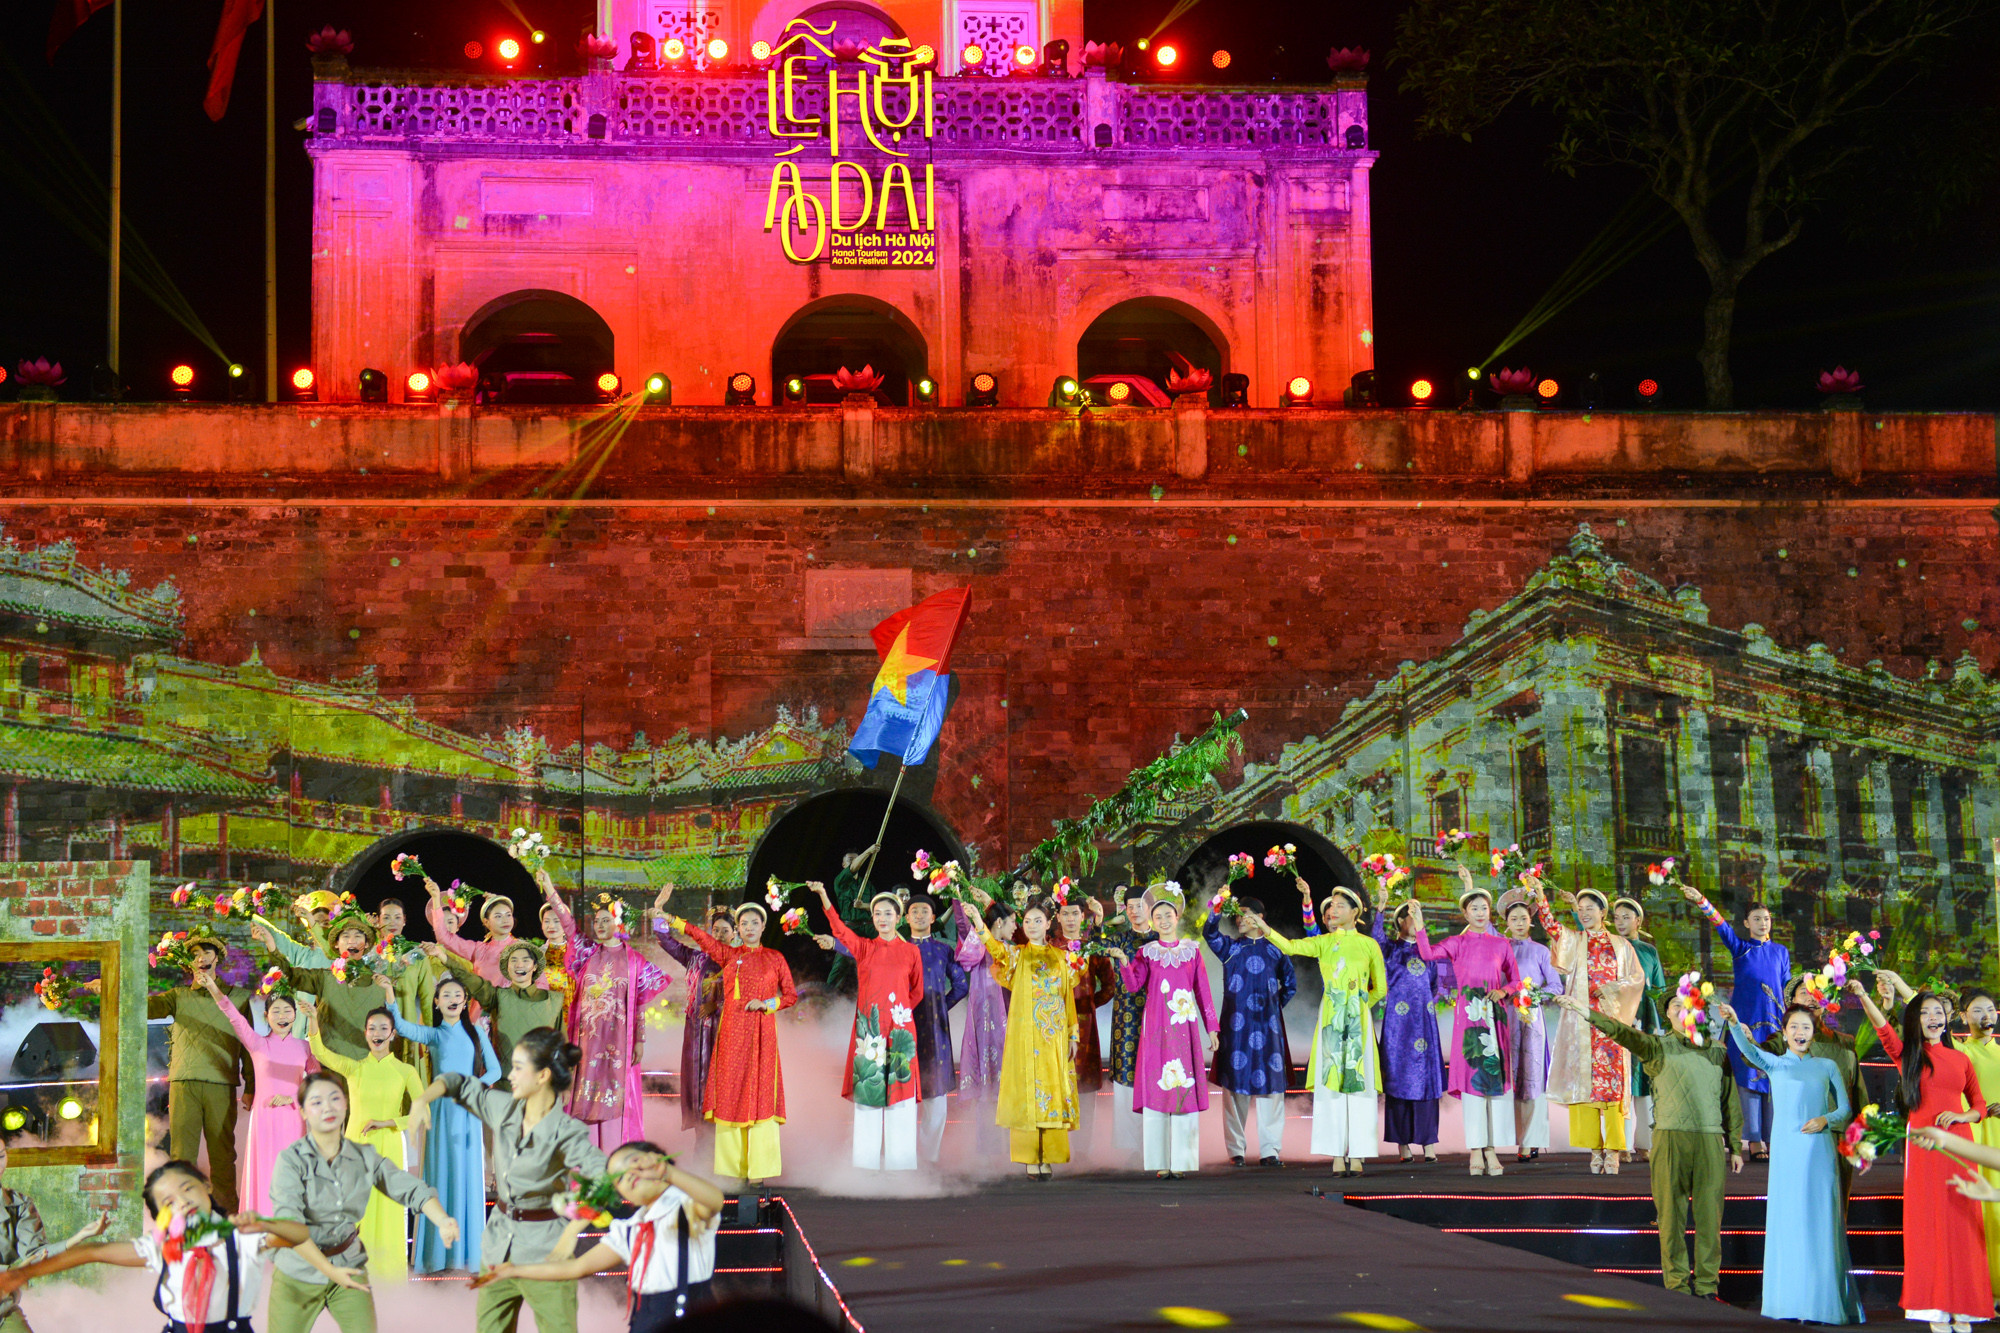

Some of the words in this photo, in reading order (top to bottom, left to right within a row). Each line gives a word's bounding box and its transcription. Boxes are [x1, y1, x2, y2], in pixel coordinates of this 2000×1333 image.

[768, 18, 836, 137] LỄ
[764, 143, 826, 262] ÁO
[831, 234, 852, 247] Du
[855, 233, 882, 250] lịch
[885, 233, 906, 247] Hà
[909, 233, 935, 250] Nội
[831, 249, 855, 257] Hanoi
[857, 249, 888, 257] Tourism
[831, 257, 843, 265] Ao
[844, 257, 857, 265] Dai
[858, 257, 888, 265] Festival
[891, 250, 935, 265] 2024
